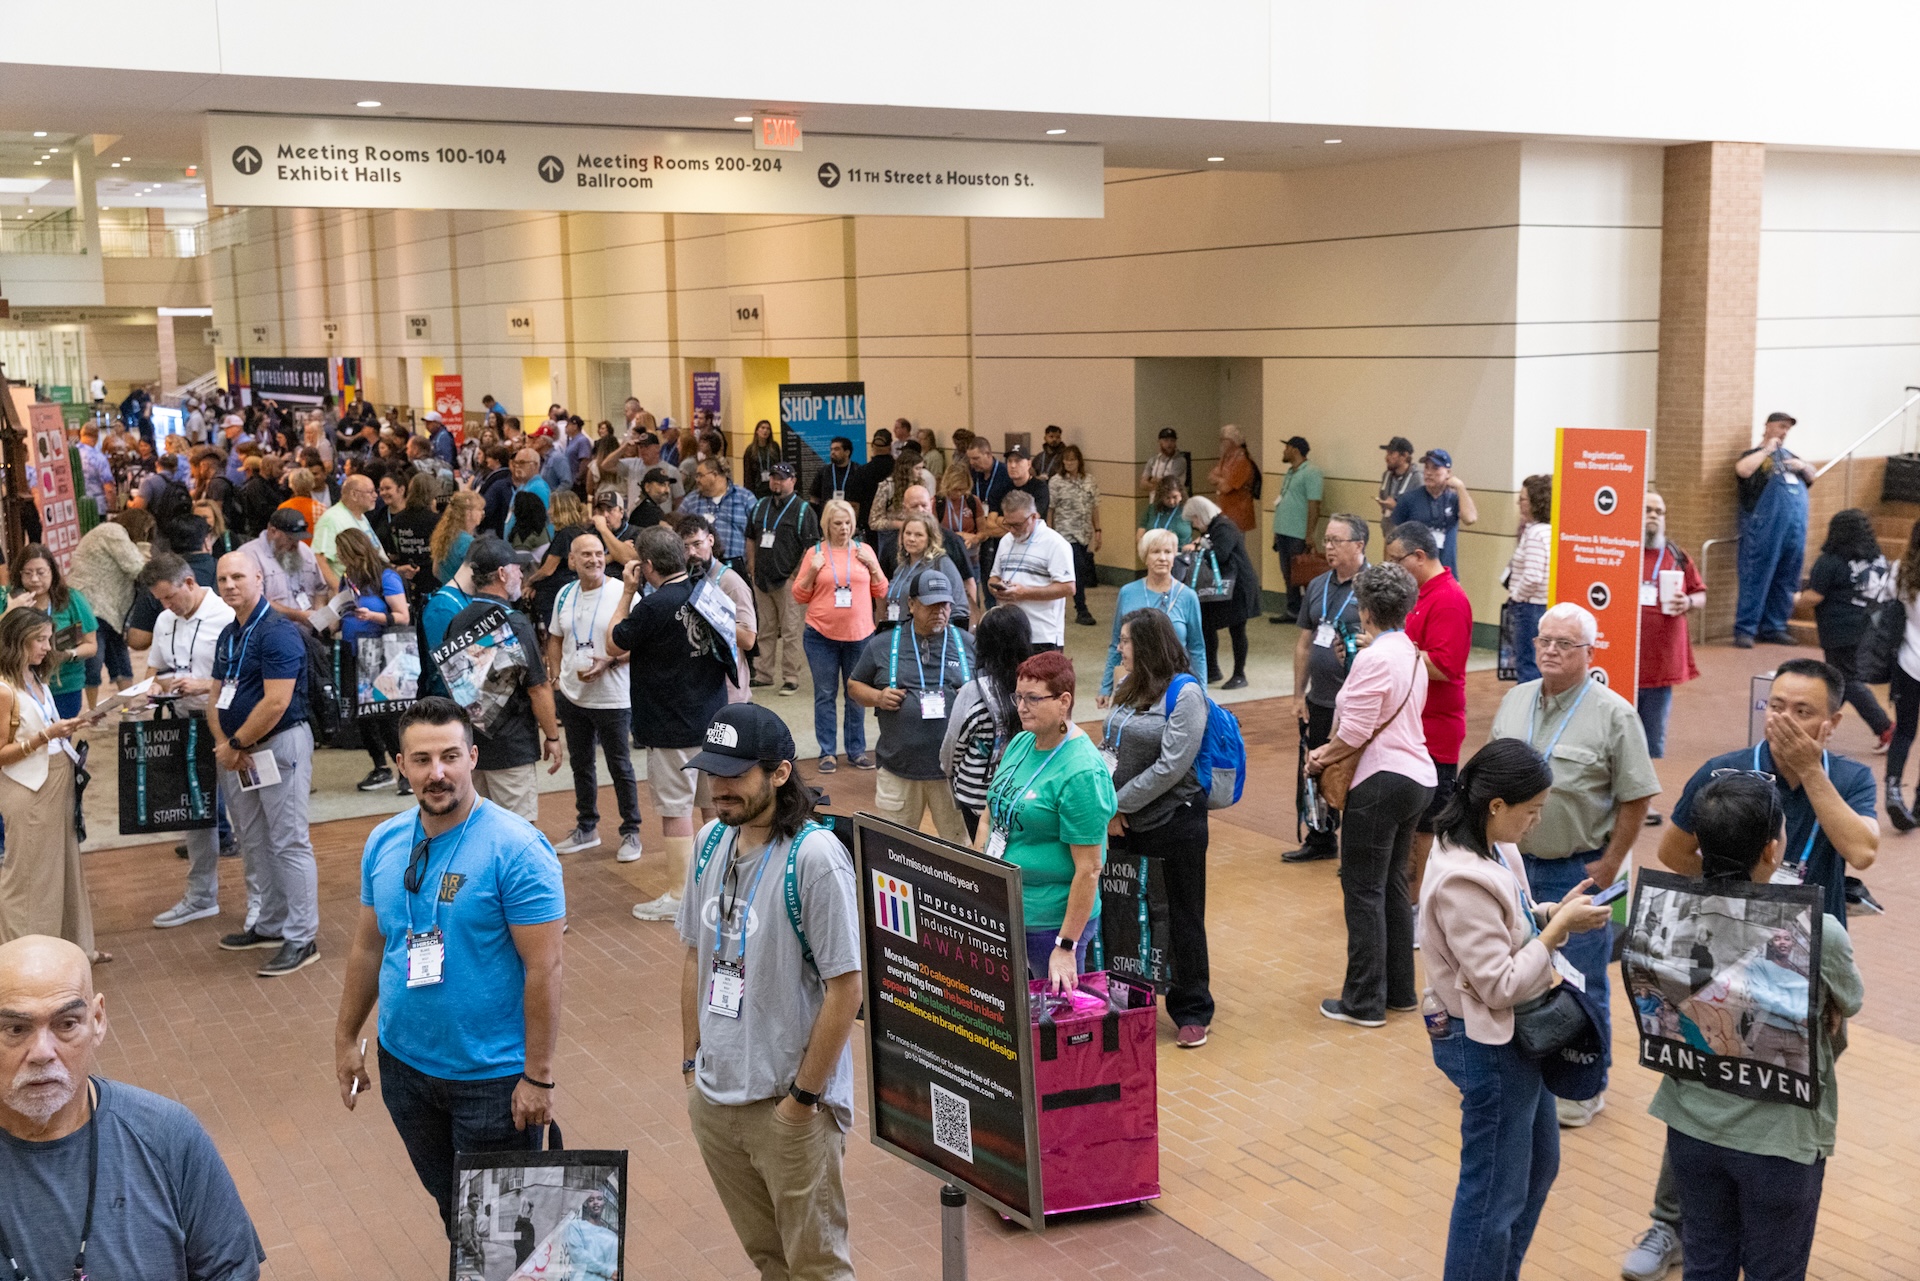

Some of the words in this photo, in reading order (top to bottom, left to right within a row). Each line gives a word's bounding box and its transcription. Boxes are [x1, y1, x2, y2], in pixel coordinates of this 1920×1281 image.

[763, 118, 795, 146] EXIT
[277, 144, 359, 164] Meeting
[365, 146, 430, 162] Rooms
[436, 148, 507, 164] 100-104
[577, 154, 648, 172] Meeting
[654, 156, 709, 171] Rooms
[715, 157, 782, 172] 200-204
[278, 165, 350, 181] Exhibit
[355, 167, 402, 183] Halls
[577, 173, 653, 188] Ballroom
[884, 169, 931, 184] Street
[935, 174, 943, 184] &
[947, 171, 1009, 187] Houston
[1014, 173, 1034, 187] St.
[410, 318, 427, 327] 103
[512, 318, 530, 328] 104
[736, 307, 759, 320] 104
[324, 324, 338, 332] 103
[416, 328, 422, 336] B
[252, 365, 299, 388] impressions
[302, 371, 325, 391] expo
[781, 396, 822, 422] SHOP
[825, 395, 865, 420] TALK
[1582, 450, 1625, 461] Registration
[1588, 461, 1609, 470] Street
[1610, 463, 1634, 473] Lobby
[1560, 532, 1592, 543] Seminars
[1600, 536, 1639, 548] Workshops
[1573, 544, 1595, 554] Arena
[1595, 546, 1625, 558] Meeting
[1575, 554, 1596, 564] Room
[474, 610, 505, 637] LANE
[433, 630, 474, 664] SEVEN
[358, 703, 386, 715] LANE
[714, 721, 727, 730] THE
[706, 736, 722, 744] FACE
[153, 808, 187, 823] STARTS
[704, 842, 714, 859] LANE
[714, 824, 724, 840] SEVE
[888, 849, 907, 866] Don't
[906, 858, 922, 871] miss
[922, 864, 933, 876] out
[933, 867, 943, 878] on
[942, 868, 957, 883] this
[956, 875, 979, 894] year's
[787, 881, 796, 905] SEVEN
[918, 887, 1006, 932] impressions
[416, 940, 438, 948] HIRSCH
[920, 913, 964, 945] industry
[968, 932, 1008, 959] impact
[923, 933, 1010, 982] AWARDS
[884, 947, 902, 965] More
[903, 953, 919, 970] than
[919, 962, 929, 974] 20
[930, 968, 970, 994] categories
[970, 987, 1005, 1011] covering
[887, 964, 925, 990] everything
[925, 980, 943, 997] from
[943, 988, 955, 1002] the
[955, 993, 974, 1010] best
[974, 1001, 981, 1013] in
[982, 1004, 1004, 1024] blank
[882, 977, 908, 996] apparel
[909, 987, 917, 1000] to
[918, 991, 930, 1005] the
[930, 997, 951, 1016] latest
[951, 1007, 993, 1036] decorating
[994, 1026, 1012, 1043] tech
[880, 989, 893, 1003] and
[893, 996, 932, 1021] excellence
[932, 1012, 939, 1026] in
[940, 1016, 974, 1043] branding
[974, 1032, 989, 1049] and
[990, 1038, 1017, 1061] design
[887, 1029, 897, 1043] For
[898, 1036, 910, 1047] more
[910, 1039, 940, 1062] information
[941, 1056, 947, 1065] or
[948, 1059, 954, 1068] to
[954, 1063, 971, 1077] enter
[971, 1070, 982, 1081] free
[983, 1075, 990, 1086] of
[990, 1080, 1014, 1100] charge,
[1644, 1039, 1706, 1077] LANE
[1719, 1061, 1810, 1102] SEVEN
[904, 1051, 912, 1060] go
[911, 1053, 919, 1063] to
[918, 1056, 995, 1100] impressionsmagazine.com
